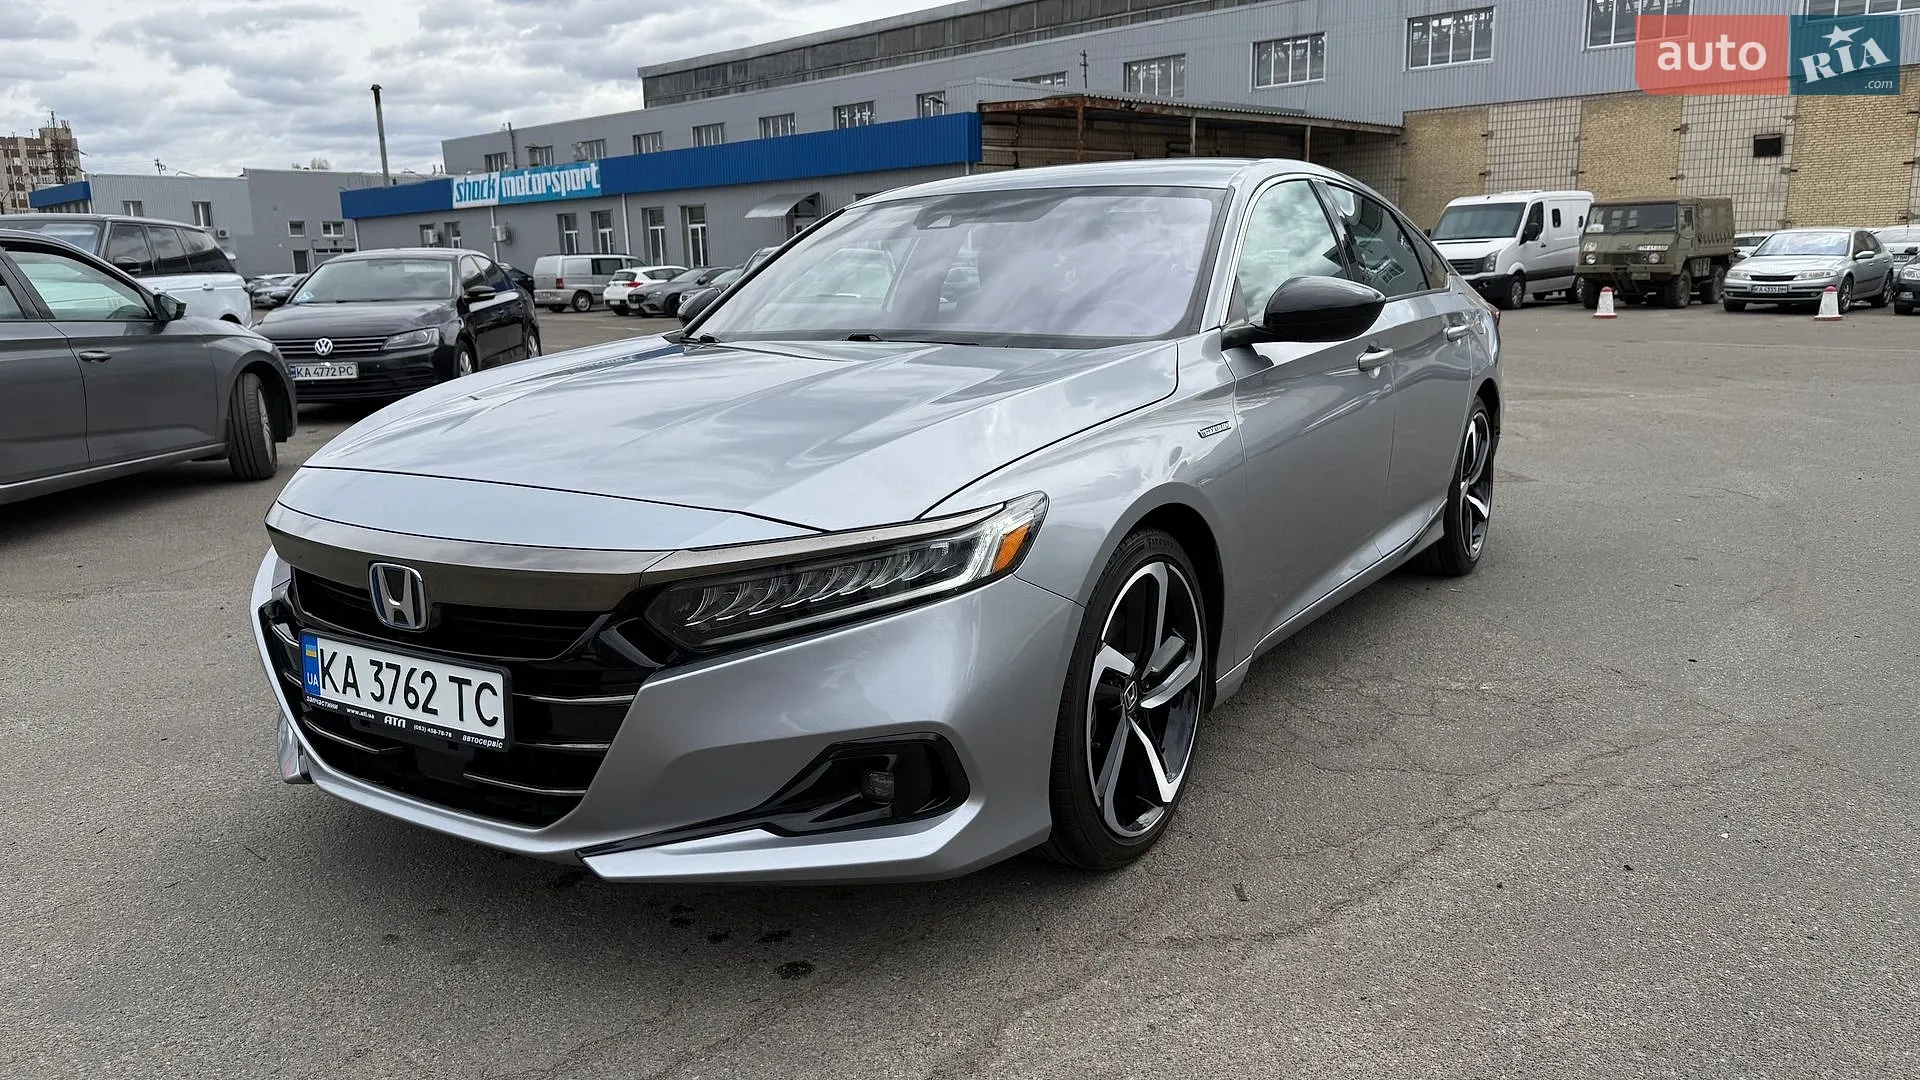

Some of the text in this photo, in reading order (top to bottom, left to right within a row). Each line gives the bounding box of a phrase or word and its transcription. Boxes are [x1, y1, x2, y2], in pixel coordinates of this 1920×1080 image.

[455, 162, 601, 203] shock motorsport
[296, 366, 354, 378] KA 4772 PC
[306, 672, 319, 686] UA
[320, 648, 499, 727] KA 3762 TC
[462, 735, 503, 749] автосервіс
